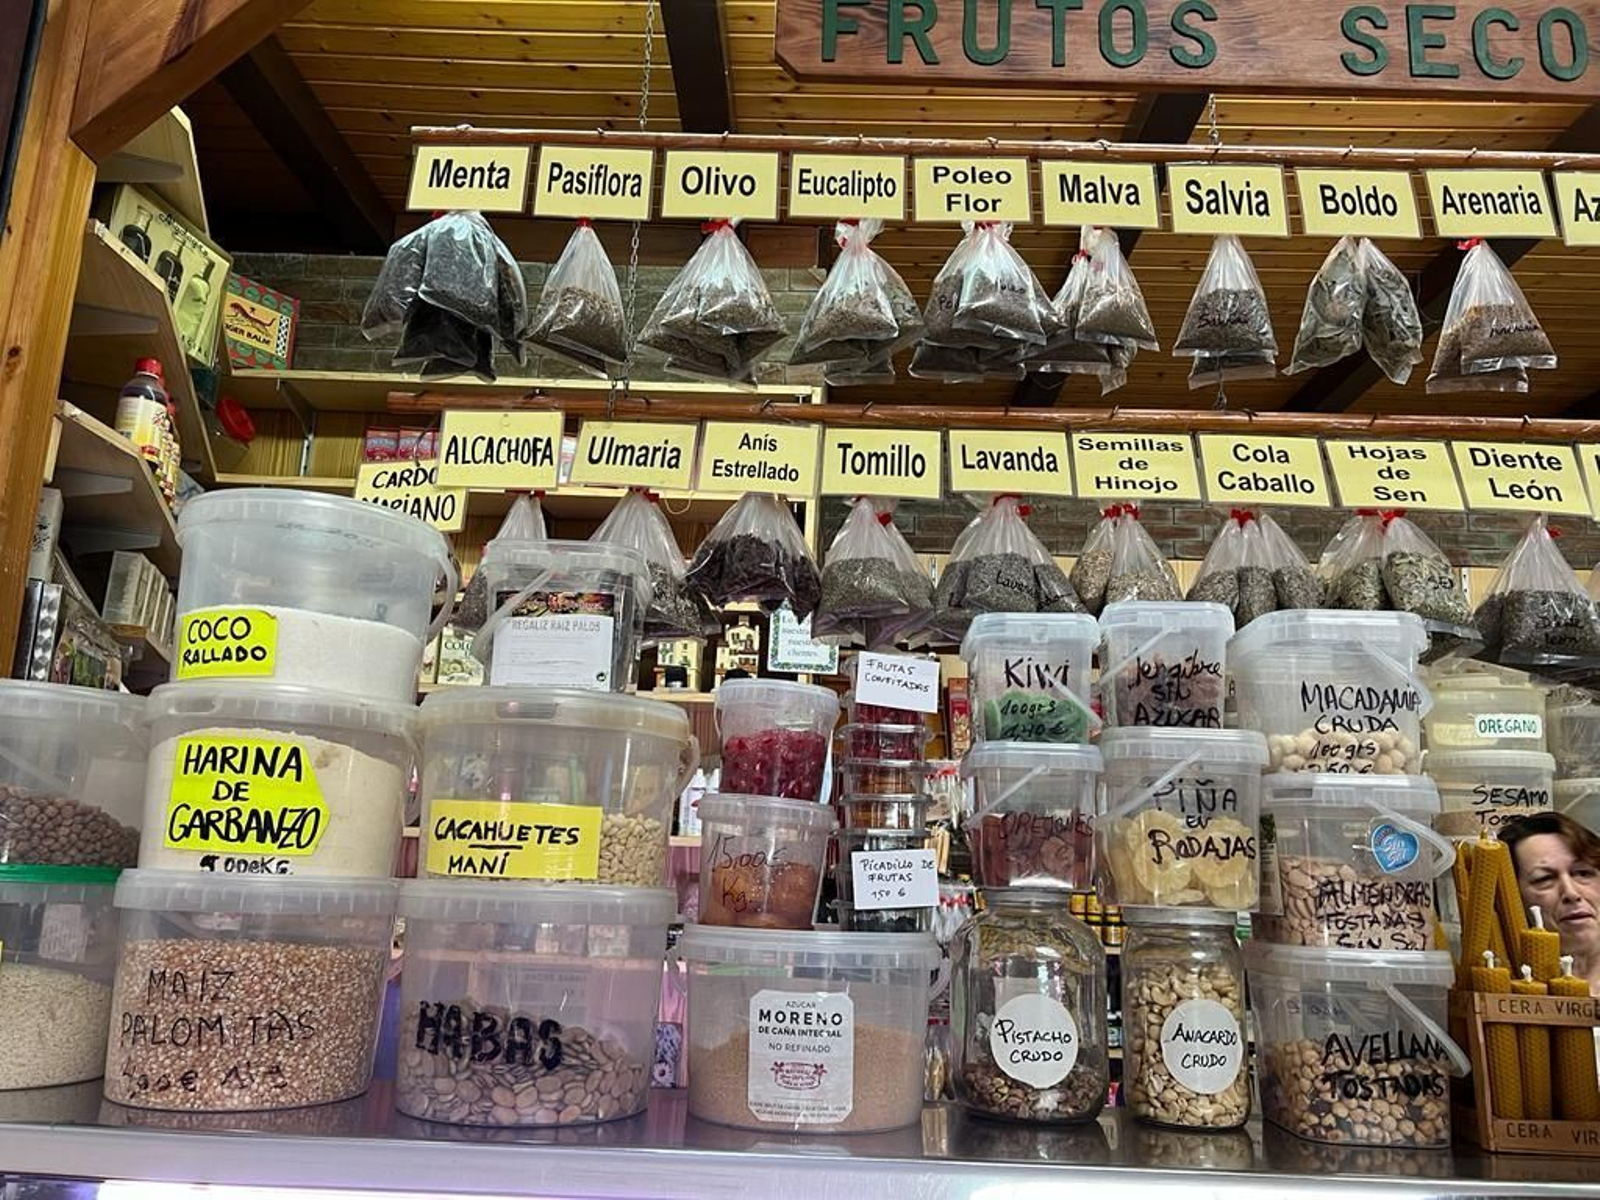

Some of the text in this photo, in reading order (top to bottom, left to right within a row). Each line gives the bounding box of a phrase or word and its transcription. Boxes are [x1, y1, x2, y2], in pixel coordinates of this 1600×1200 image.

[821, 0, 1588, 81] FRUTOS SECO
[428, 158, 511, 190] Menta
[547, 161, 642, 198] Pasiflora
[681, 165, 756, 197] Olivo
[798, 167, 897, 203] Eucalipto
[932, 165, 1012, 185] Poleo
[1059, 173, 1141, 206] Malva
[1184, 178, 1270, 217] Salvia
[1319, 183, 1398, 218] Boldo
[1441, 184, 1543, 216] Arenaria
[946, 193, 1002, 213] Flor
[444, 434, 554, 468] ALCACHOFA
[588, 436, 682, 471] Ulmaria
[738, 432, 778, 453] Anís
[1078, 437, 1184, 452] Semillas
[1232, 443, 1290, 464] Cola
[1348, 445, 1427, 463] Hojas
[711, 458, 800, 483] Estrellado
[837, 442, 926, 478] Tomillo
[961, 444, 1059, 473] Lavanda
[1118, 457, 1149, 471] de
[1469, 447, 1563, 471] Diente
[1095, 475, 1178, 494] Hinojo
[1217, 470, 1315, 495] Caballo
[1377, 465, 1411, 481] de
[1373, 486, 1427, 502] Sen
[1488, 477, 1563, 502] León
[361, 492, 456, 523] RIANO
[187, 616, 251, 644] COCO
[511, 619, 601, 632] REGALIZ RAIZ PALOS
[182, 645, 267, 668] RALLADO
[866, 658, 916, 675] FRUTAS
[1300, 681, 1422, 715] MACADAMIA
[1314, 713, 1400, 734] CRUDA
[1478, 719, 1538, 734] OREGANO
[183, 743, 303, 783] HARINA
[212, 780, 250, 802] DE
[1471, 784, 1549, 808] SESAMO
[168, 802, 321, 850] GARBANZO
[434, 815, 580, 846] CACAHUETES
[447, 851, 510, 876] MANÍ
[921, 860, 935, 869] DE
[867, 872, 912, 883] FRUTAS
[1316, 911, 1426, 930] TOSTADAS
[758, 1009, 843, 1026] MORENO
[1498, 999, 1544, 1015] CERA
[120, 1010, 316, 1047] PALOMTAS
[415, 999, 564, 1070] HABAS
[758, 1025, 770, 1034] DE
[771, 1026, 796, 1037] CAÑA
[1171, 1022, 1238, 1046] ANACARDO
[768, 1042, 831, 1053] NO REFINADO
[1009, 1049, 1064, 1064] CRUDO
[1180, 1053, 1227, 1068] CRUDO
[1506, 1123, 1552, 1139] CERA
